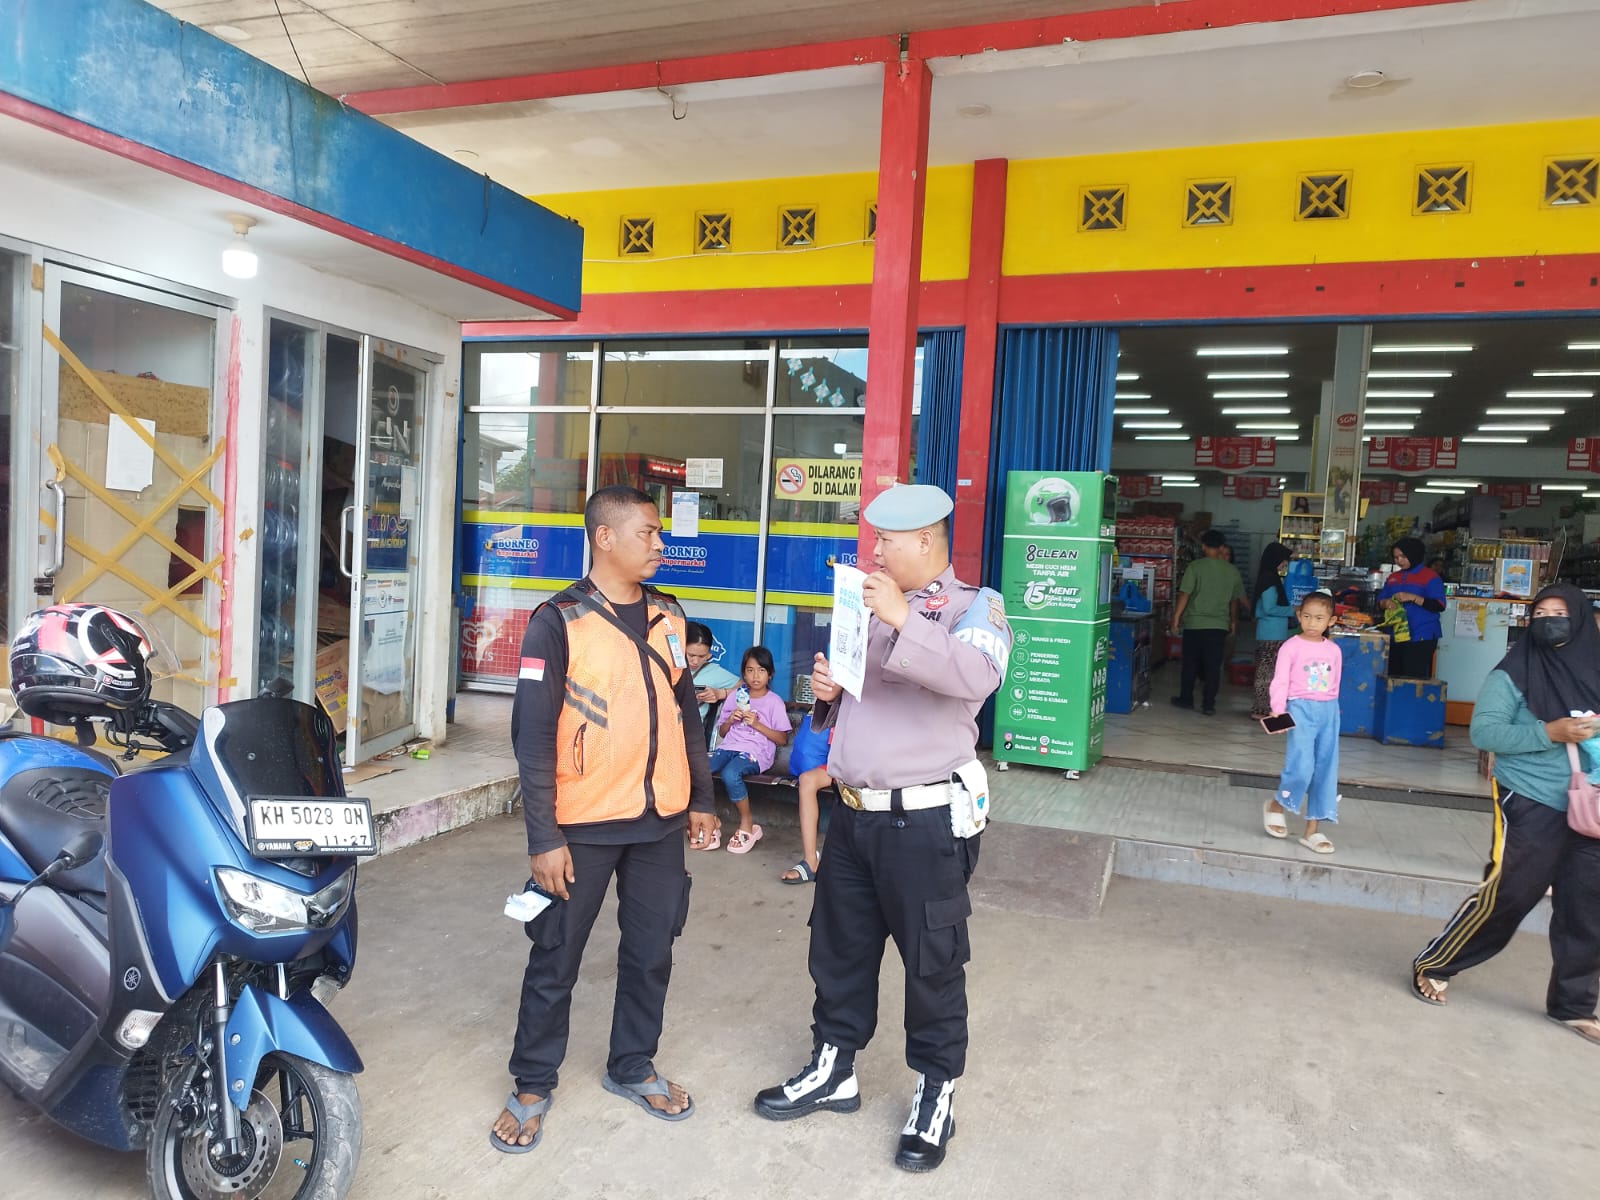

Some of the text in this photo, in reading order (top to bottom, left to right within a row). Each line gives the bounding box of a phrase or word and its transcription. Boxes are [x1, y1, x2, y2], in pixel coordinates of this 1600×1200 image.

[808, 465, 856, 480] DILARANG
[813, 481, 823, 495] DI
[825, 483, 856, 496] DALAM
[497, 538, 540, 550] BORNEO
[662, 545, 708, 559] BORNEO
[660, 557, 706, 568] Supermarket
[1030, 585, 1049, 603] 5
[1049, 586, 1079, 596] MENIT
[260, 805, 284, 825] KH
[291, 806, 334, 825] 5028
